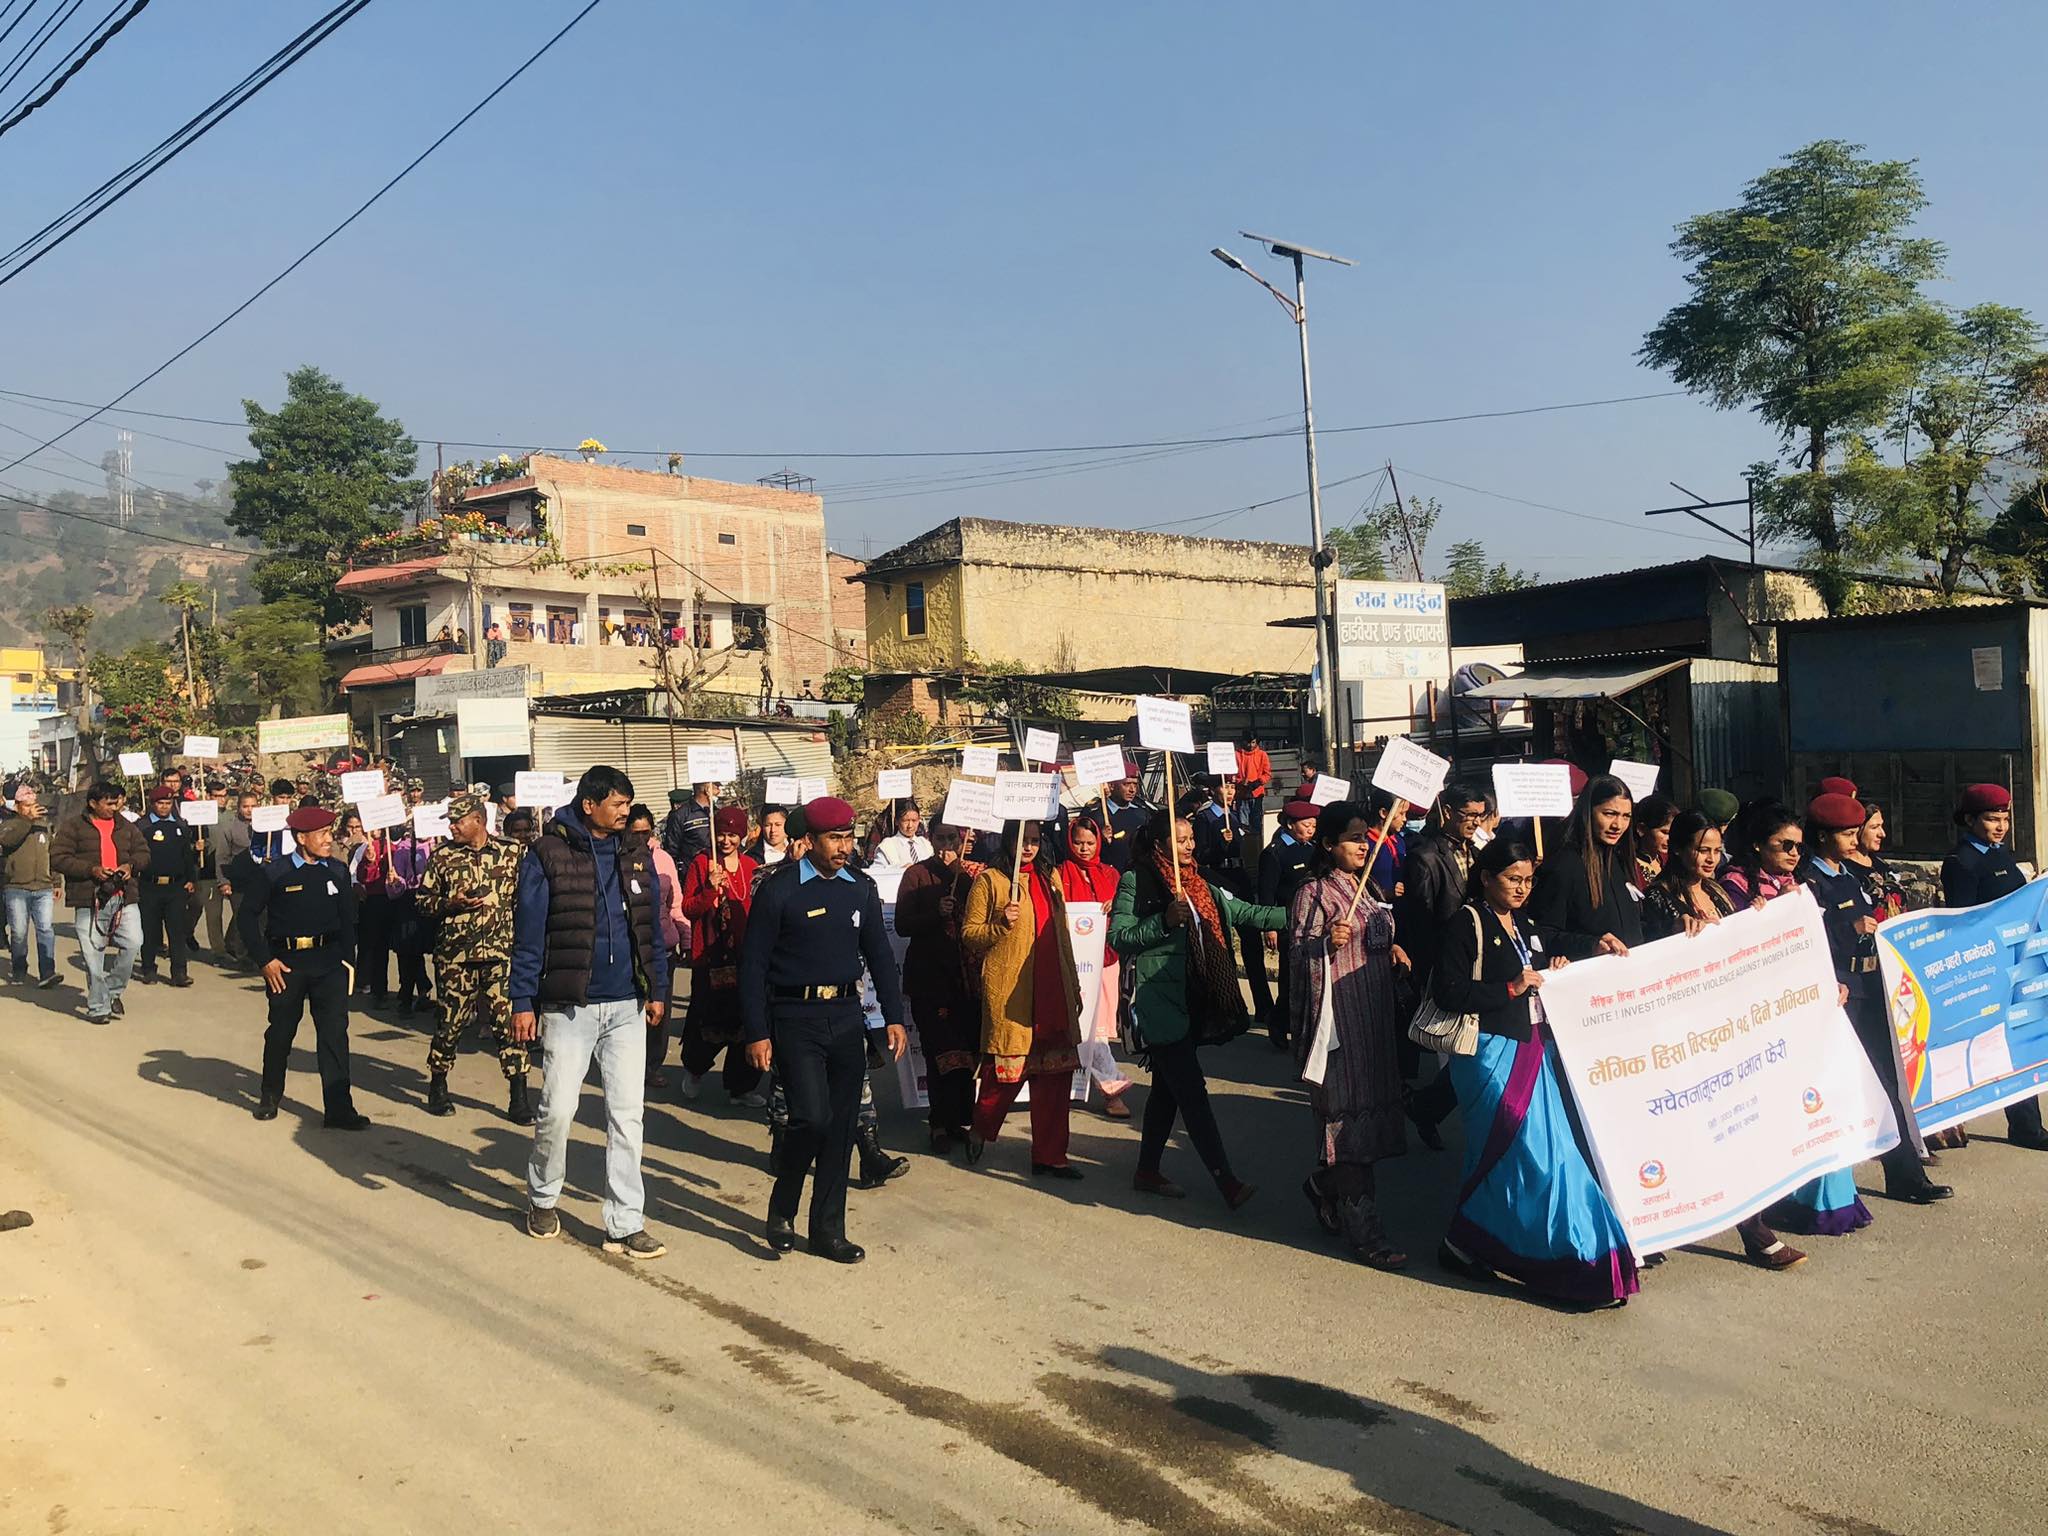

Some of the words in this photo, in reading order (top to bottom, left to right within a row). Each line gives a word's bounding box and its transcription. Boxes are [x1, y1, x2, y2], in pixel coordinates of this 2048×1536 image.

[1582, 1011, 1613, 1028] UNITE
[1621, 1001, 1655, 1018] INVEST
[1656, 996, 1667, 1008] TO
[1667, 983, 1701, 1006] PREVENT
[1703, 970, 1735, 992] VIOLENCE
[1735, 959, 1760, 978] AGAINST
[1761, 949, 1785, 967] WOMEN
[1790, 939, 1810, 955] GIRLS
[1587, 1055, 1646, 1087] लैंगिक
[1652, 1042, 1687, 1071] हिंसा
[1751, 999, 1772, 1031] दिने
[1775, 983, 1821, 1018] अभियान
[1646, 1067, 1735, 1117] सचेतनामूलक
